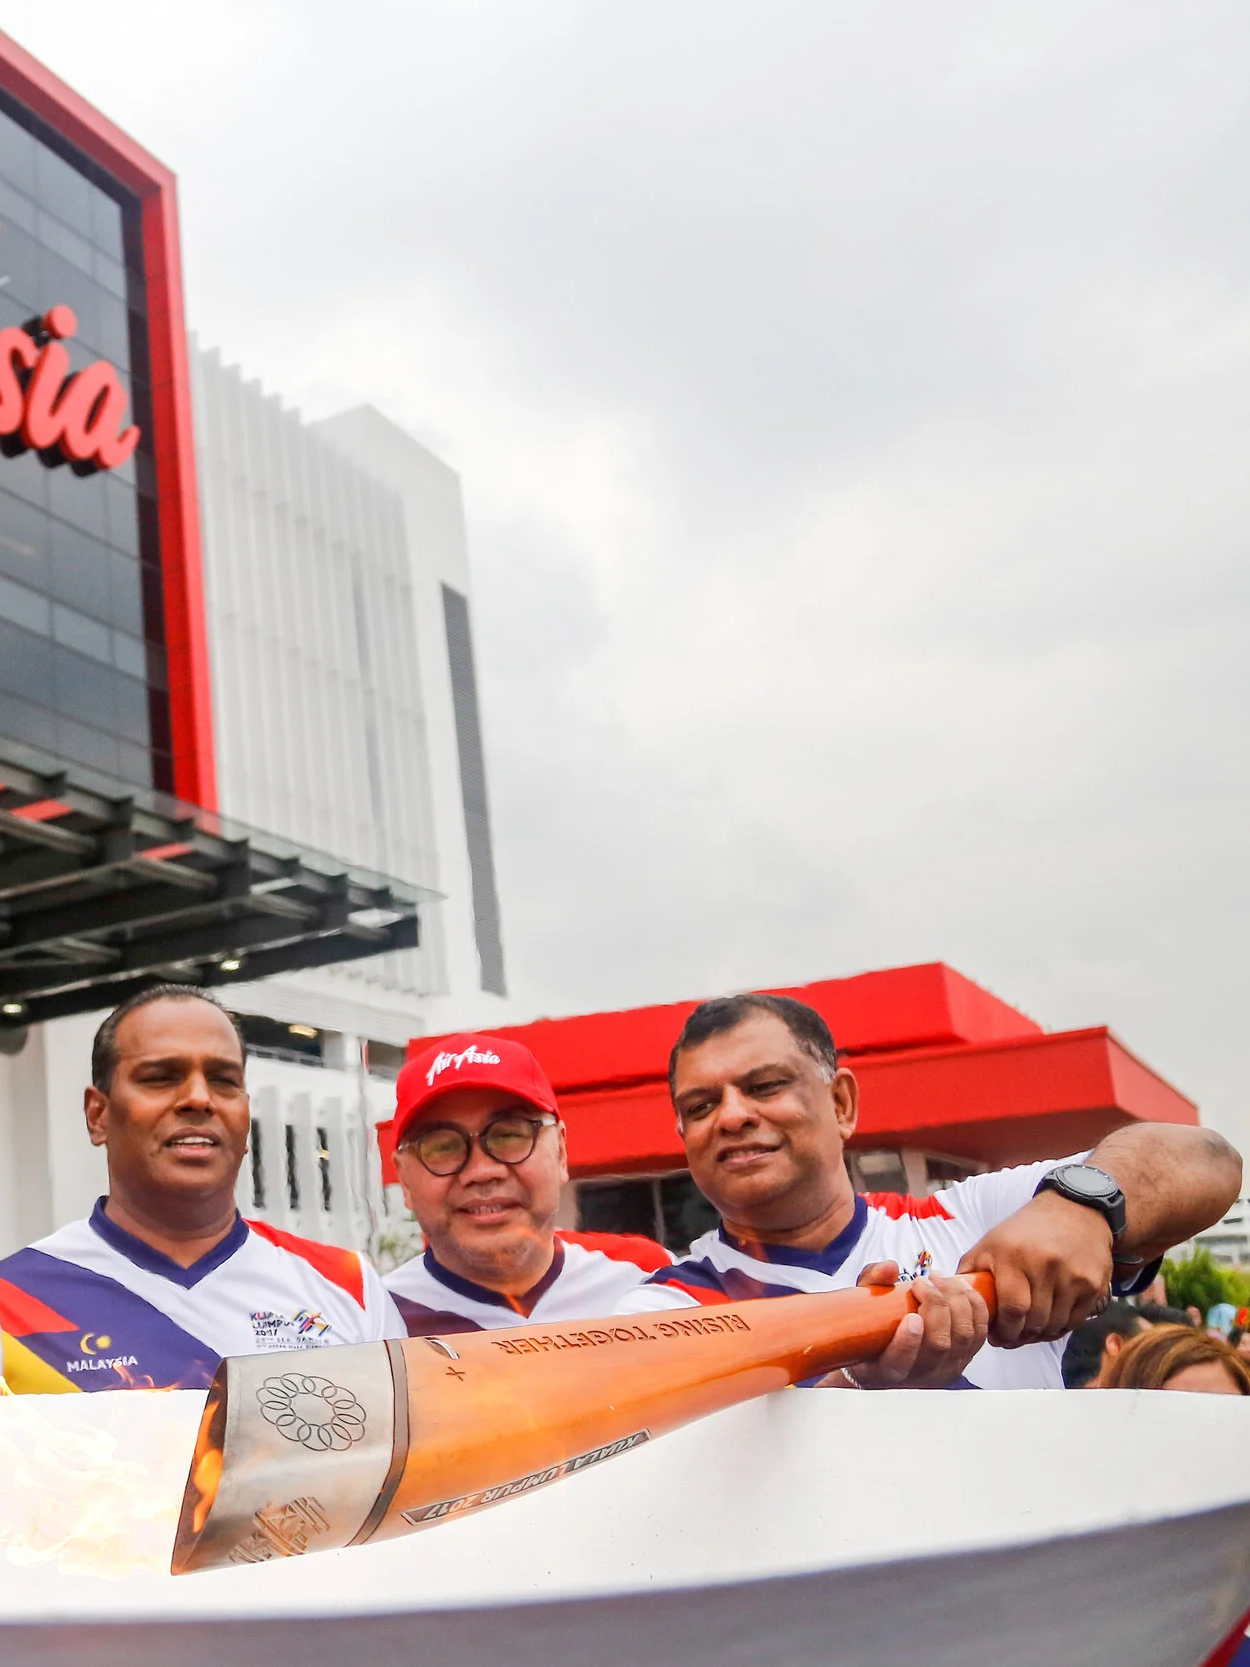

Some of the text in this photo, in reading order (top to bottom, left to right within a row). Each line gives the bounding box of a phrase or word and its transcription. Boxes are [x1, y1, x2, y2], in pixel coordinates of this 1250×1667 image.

[491, 1314, 751, 1355] RISING TOGETHER
[66, 1355, 138, 1372] MALAYSIA
[422, 1434, 642, 1521] KUALA LUMPUR 2017
